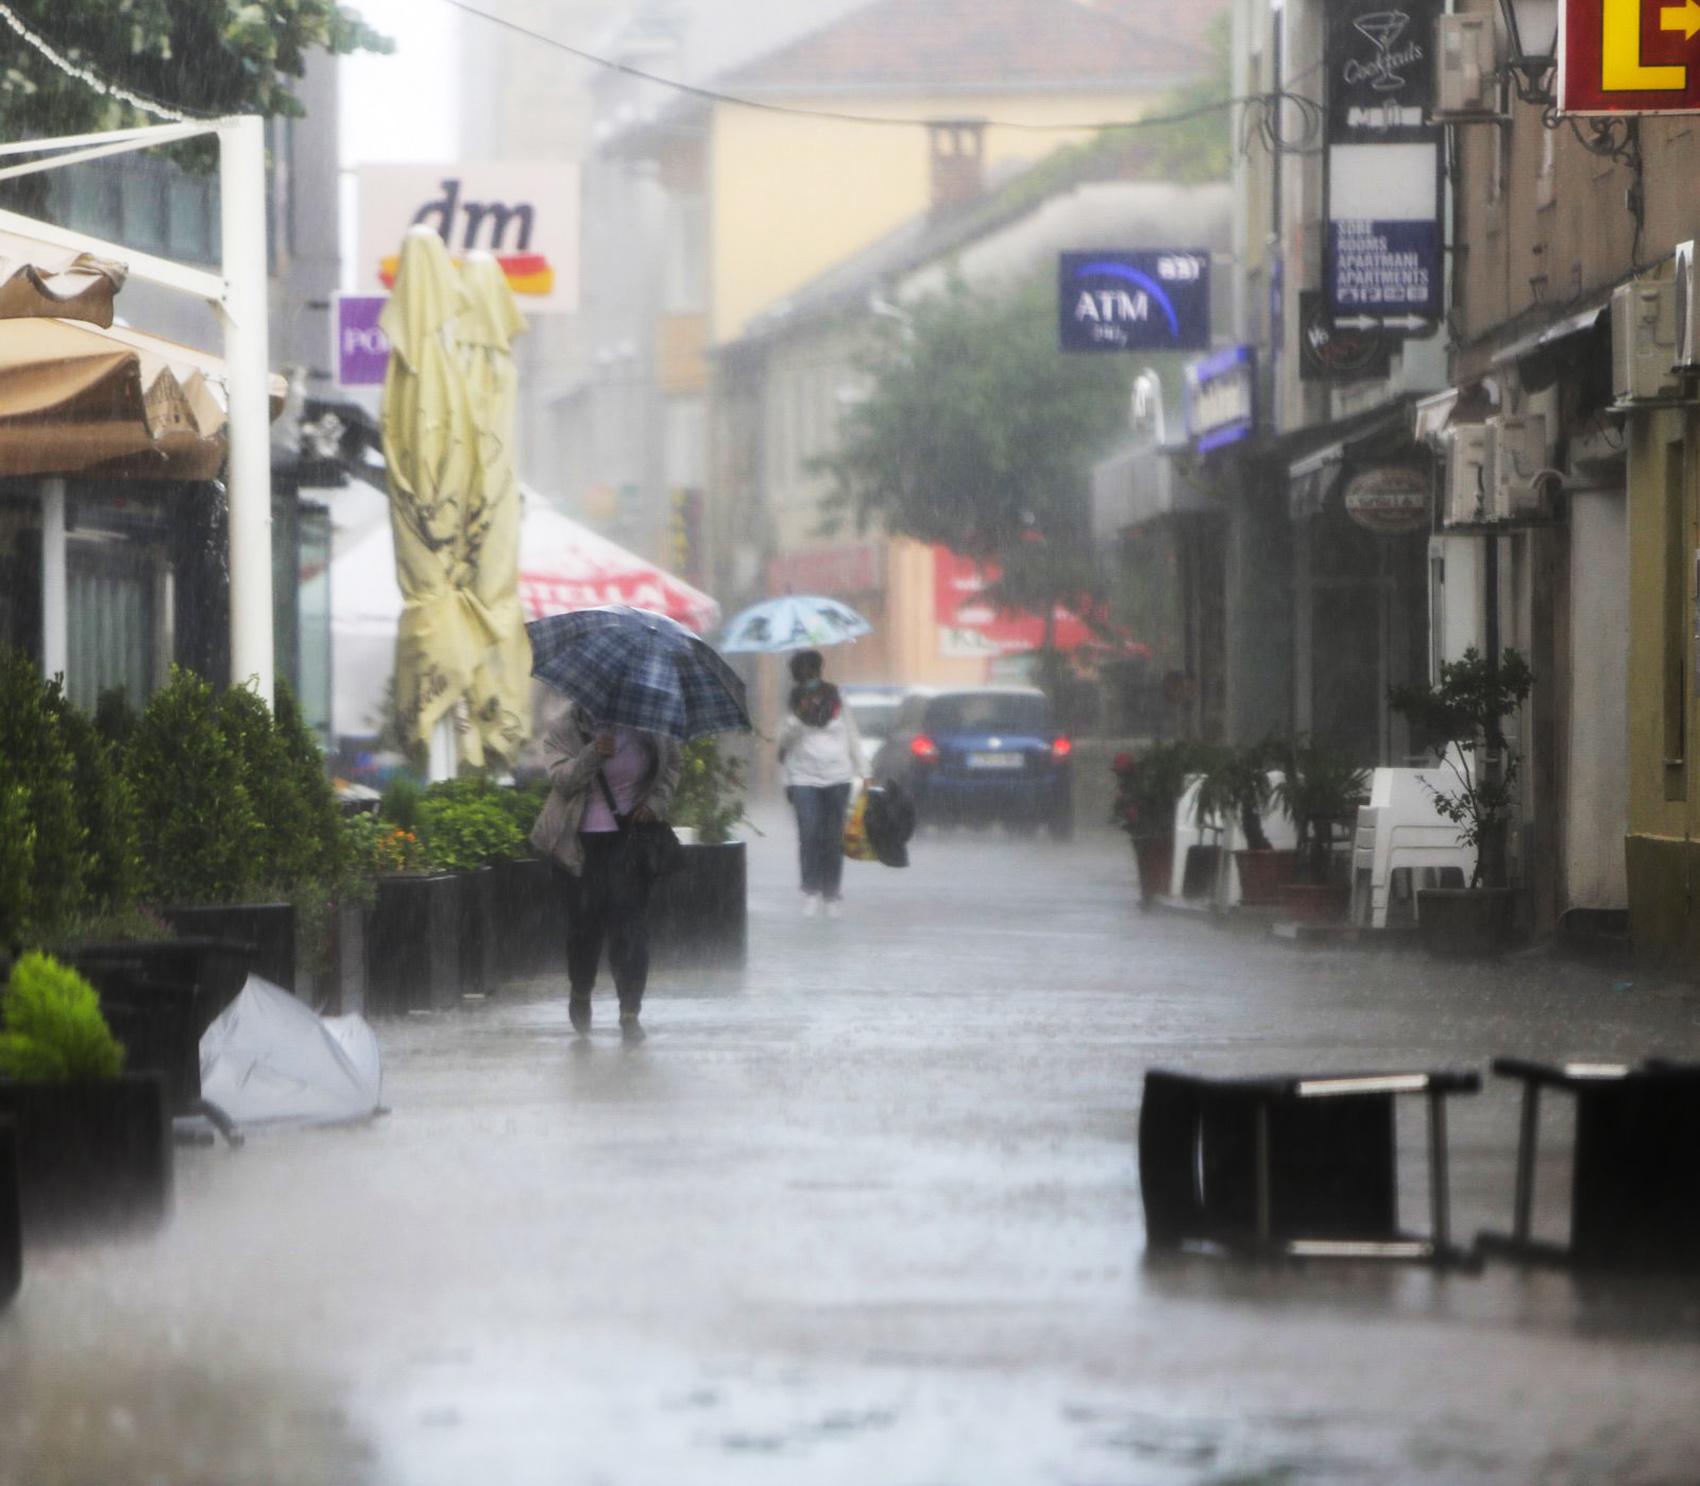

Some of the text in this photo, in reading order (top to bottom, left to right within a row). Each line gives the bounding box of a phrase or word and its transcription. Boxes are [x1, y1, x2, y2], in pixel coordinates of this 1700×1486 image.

[411, 180, 535, 250] dm
[1337, 269, 1429, 286] APARTMENTS
[1074, 290, 1148, 321] ATM
